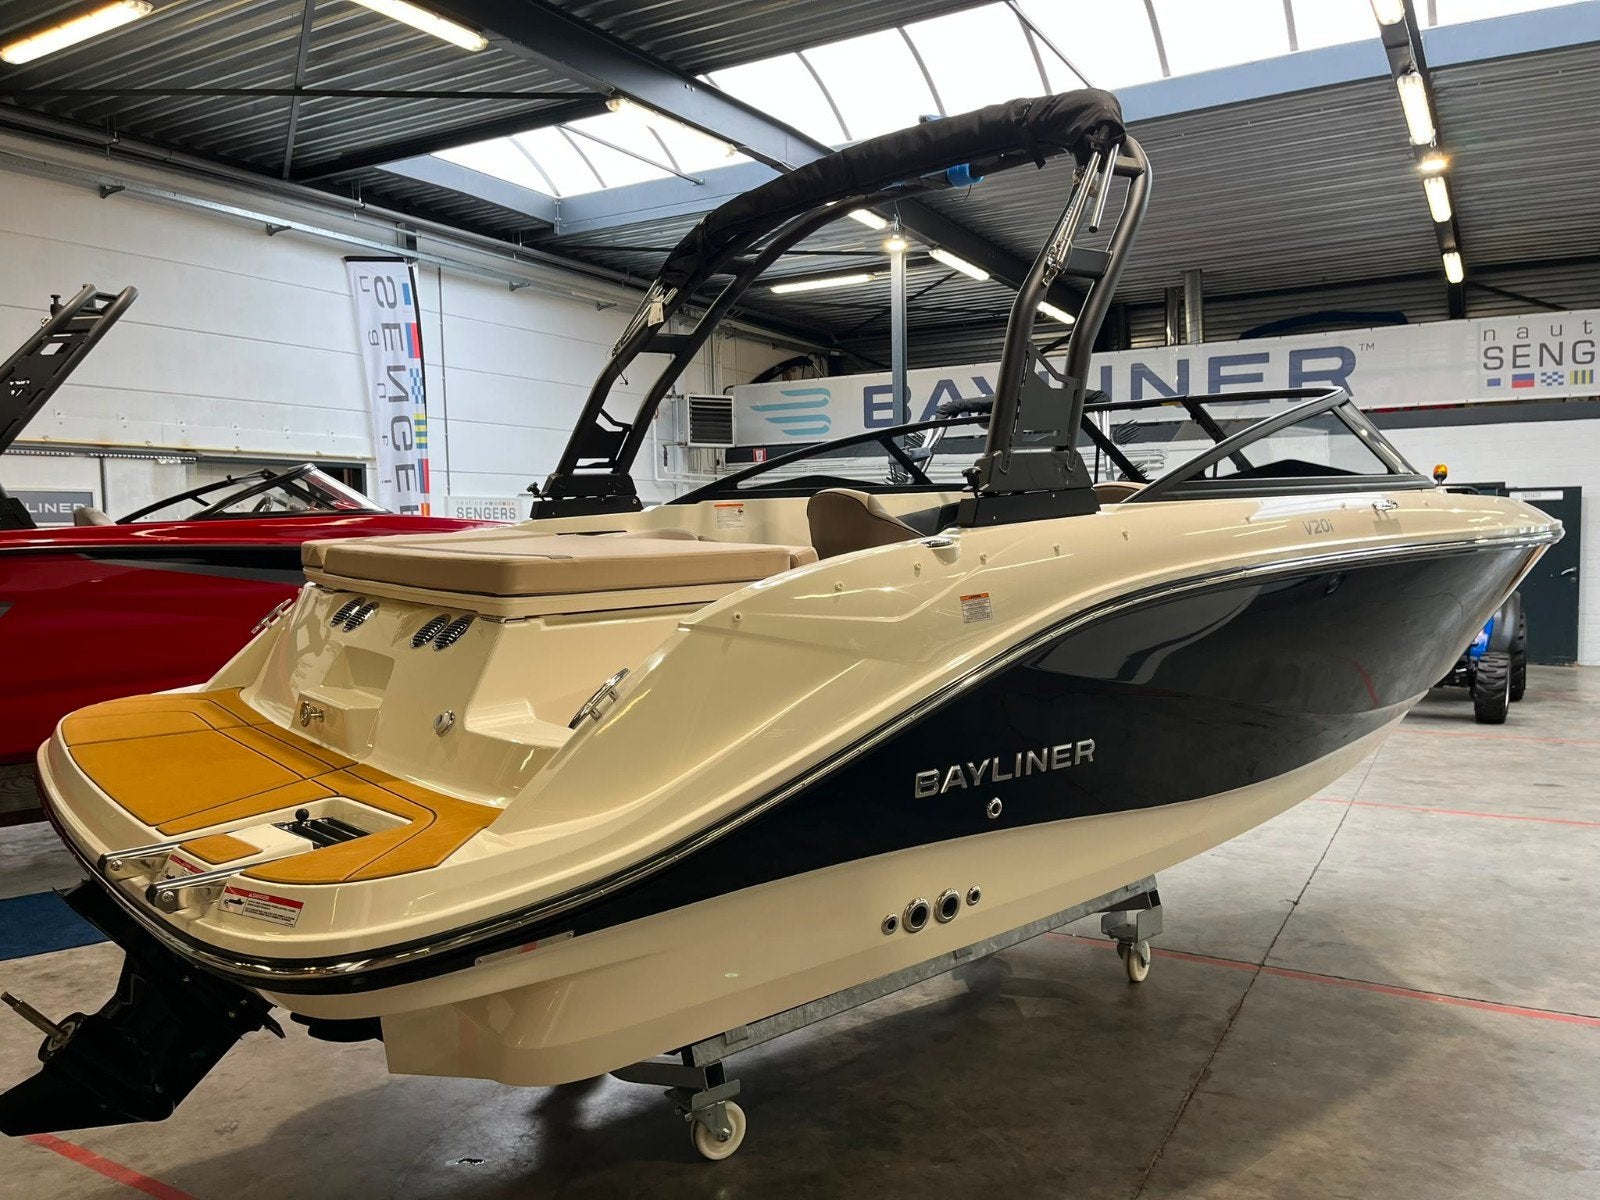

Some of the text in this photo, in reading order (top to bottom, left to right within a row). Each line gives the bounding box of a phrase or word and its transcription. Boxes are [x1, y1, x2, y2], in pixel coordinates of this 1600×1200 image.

[1483, 319, 1593, 342] naut
[1483, 339, 1596, 370] SENG
[863, 346, 1357, 430] BAINER
[456, 507, 516, 519] SENGERS
[914, 738, 1096, 799] BAYLINER
